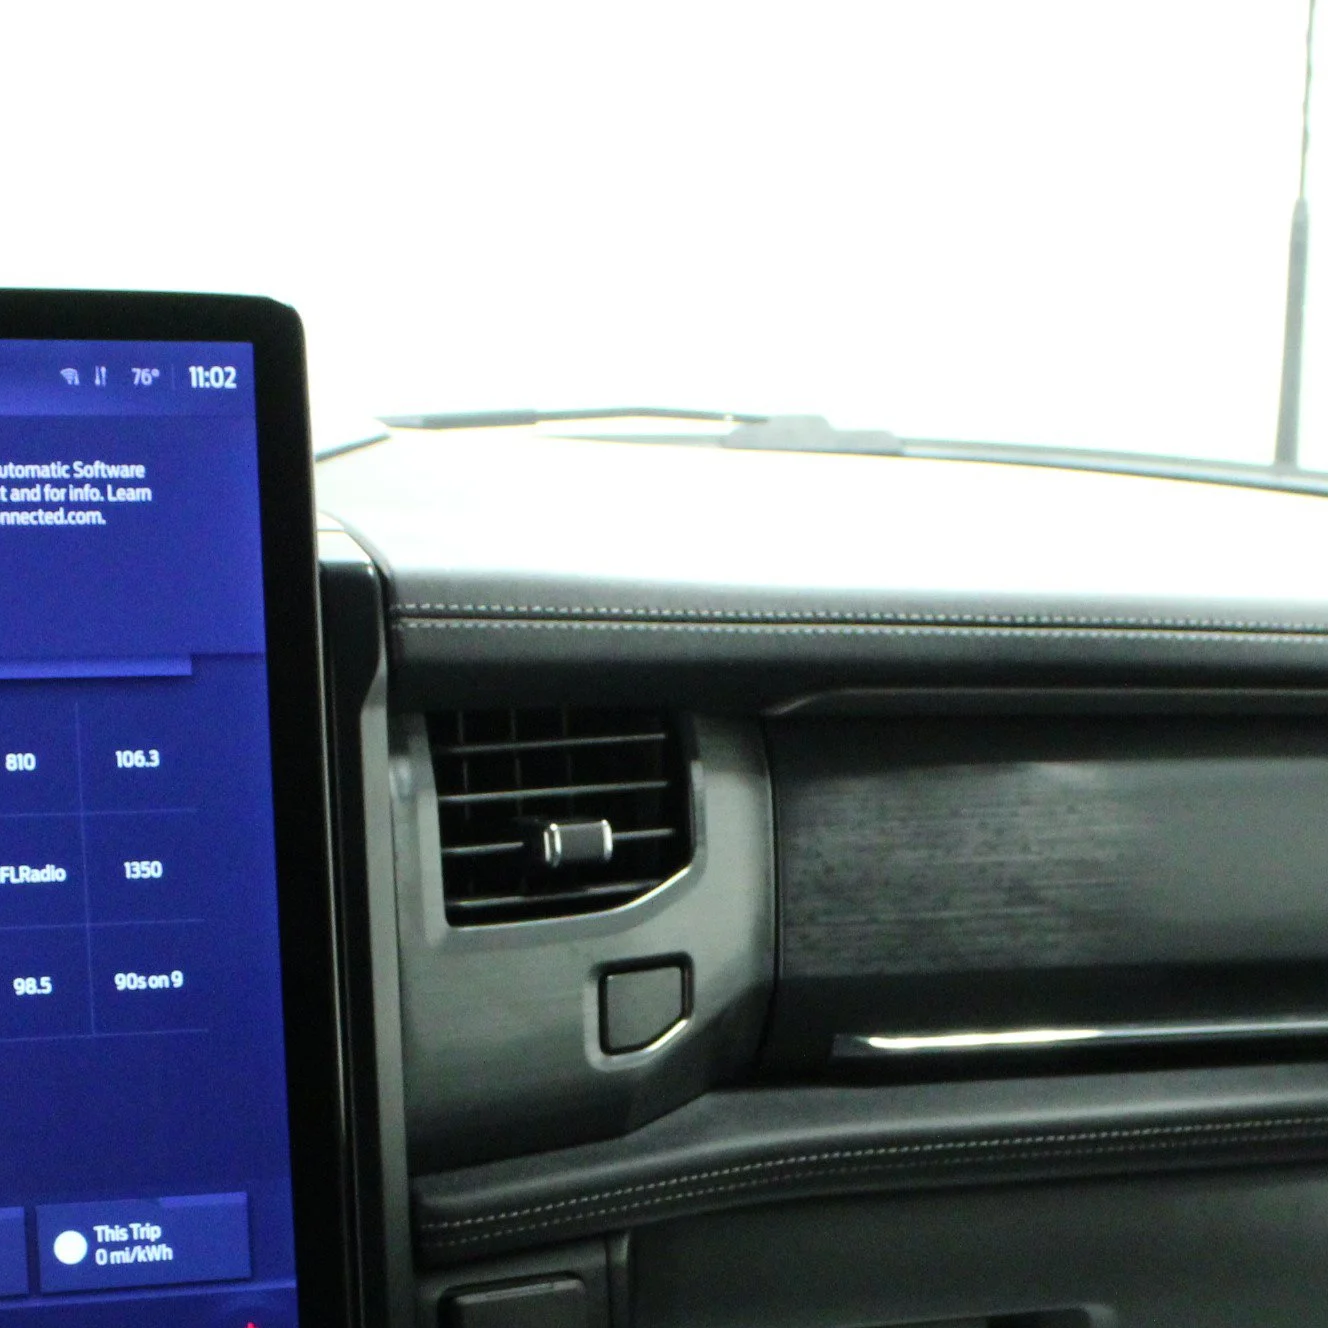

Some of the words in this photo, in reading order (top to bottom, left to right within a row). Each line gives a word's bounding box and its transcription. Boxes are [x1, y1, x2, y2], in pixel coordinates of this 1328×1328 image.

[188, 365, 237, 389] 11:02
[72, 459, 146, 479] Software
[9, 483, 42, 503] and
[43, 483, 67, 503] for
[68, 483, 105, 502] info.
[106, 483, 153, 503] Learn
[5, 752, 37, 772] 810
[115, 749, 161, 769] 106.3
[123, 860, 164, 880] 1350
[12, 976, 53, 996] 98.5
[114, 972, 146, 991] 90s
[147, 974, 169, 990] on
[170, 970, 184, 989] 9
[92, 1224, 129, 1243] This
[129, 1222, 162, 1243] Trip
[94, 1248, 109, 1266] 0
[109, 1243, 174, 1265] mi/kWh
